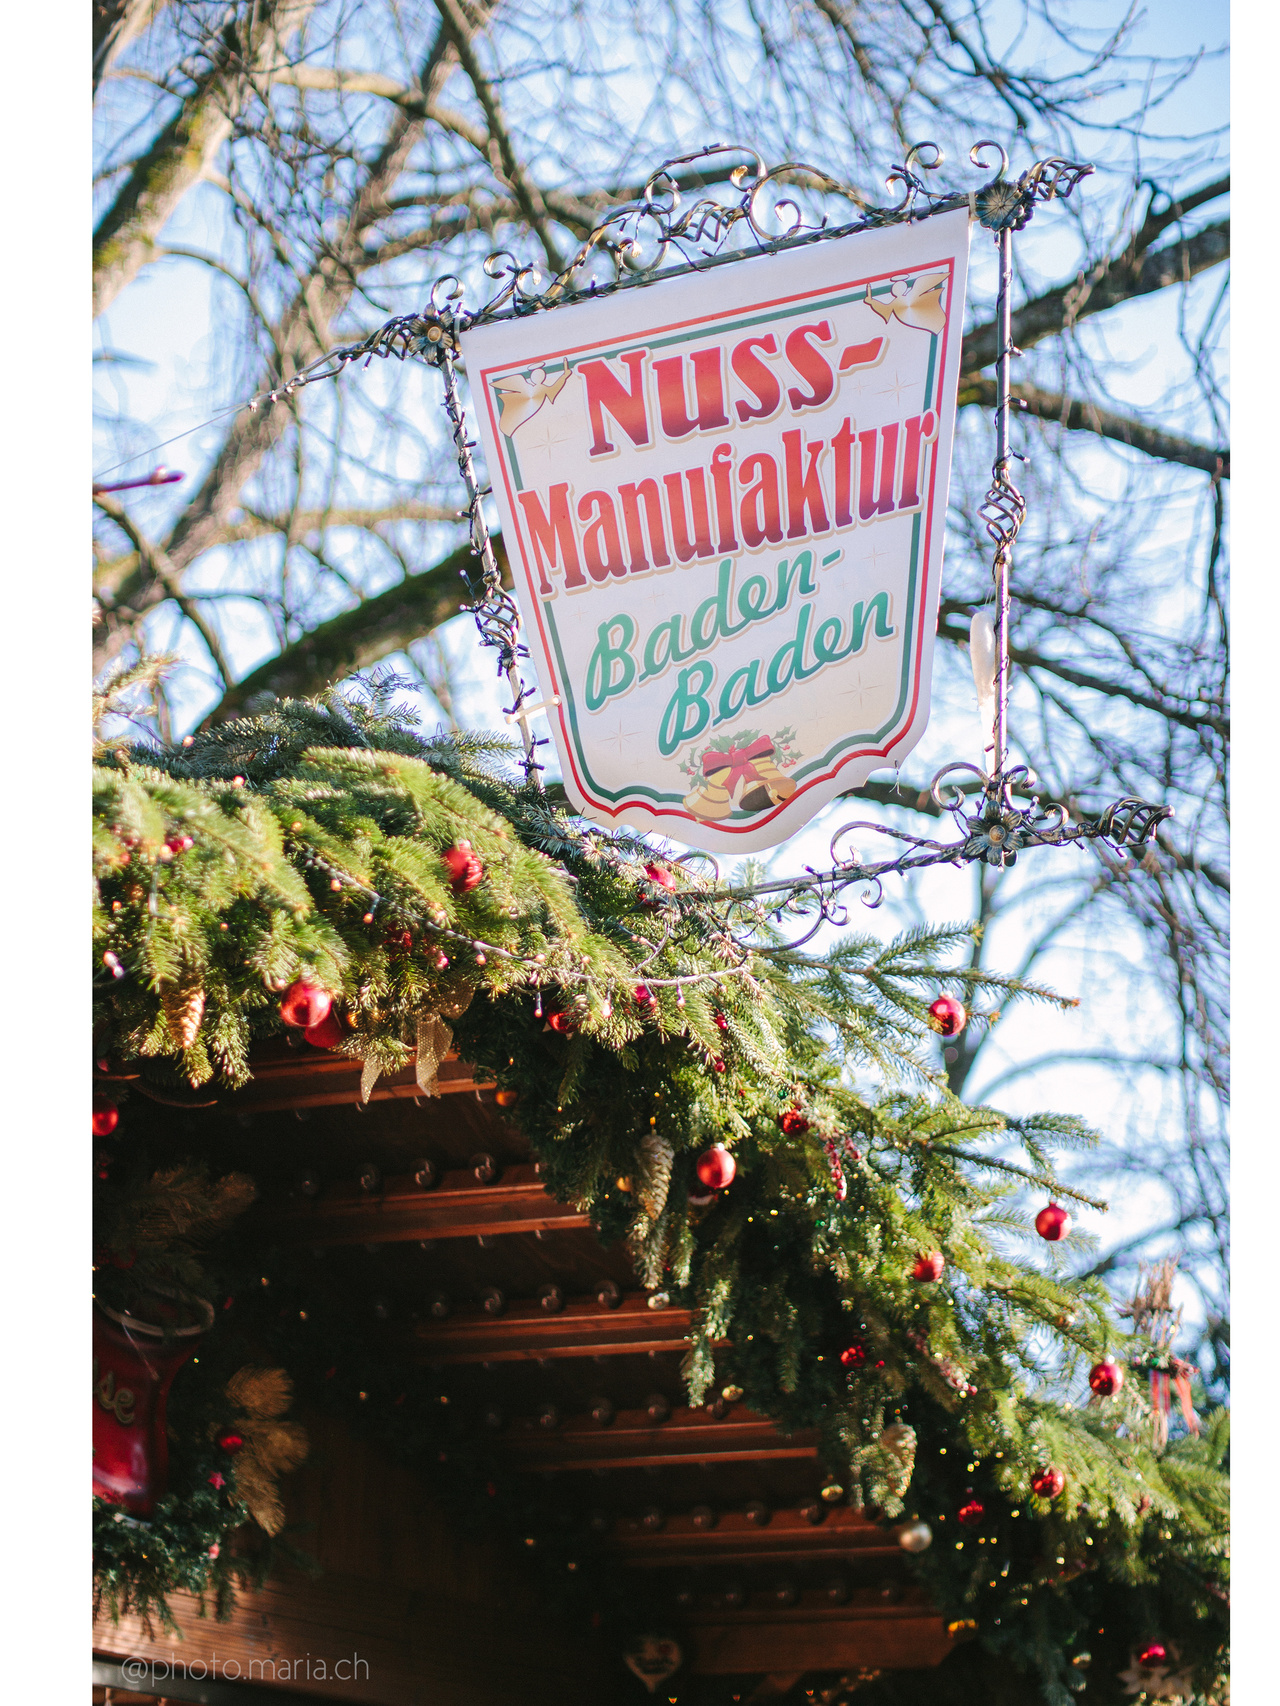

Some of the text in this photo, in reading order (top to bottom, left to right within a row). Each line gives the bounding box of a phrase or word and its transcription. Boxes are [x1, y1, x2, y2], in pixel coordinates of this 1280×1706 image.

[577, 319, 885, 457] Nuss-
[517, 408, 938, 597] Manufaktur
[585, 549, 843, 712] Baden-
[657, 591, 895, 756] Baden
